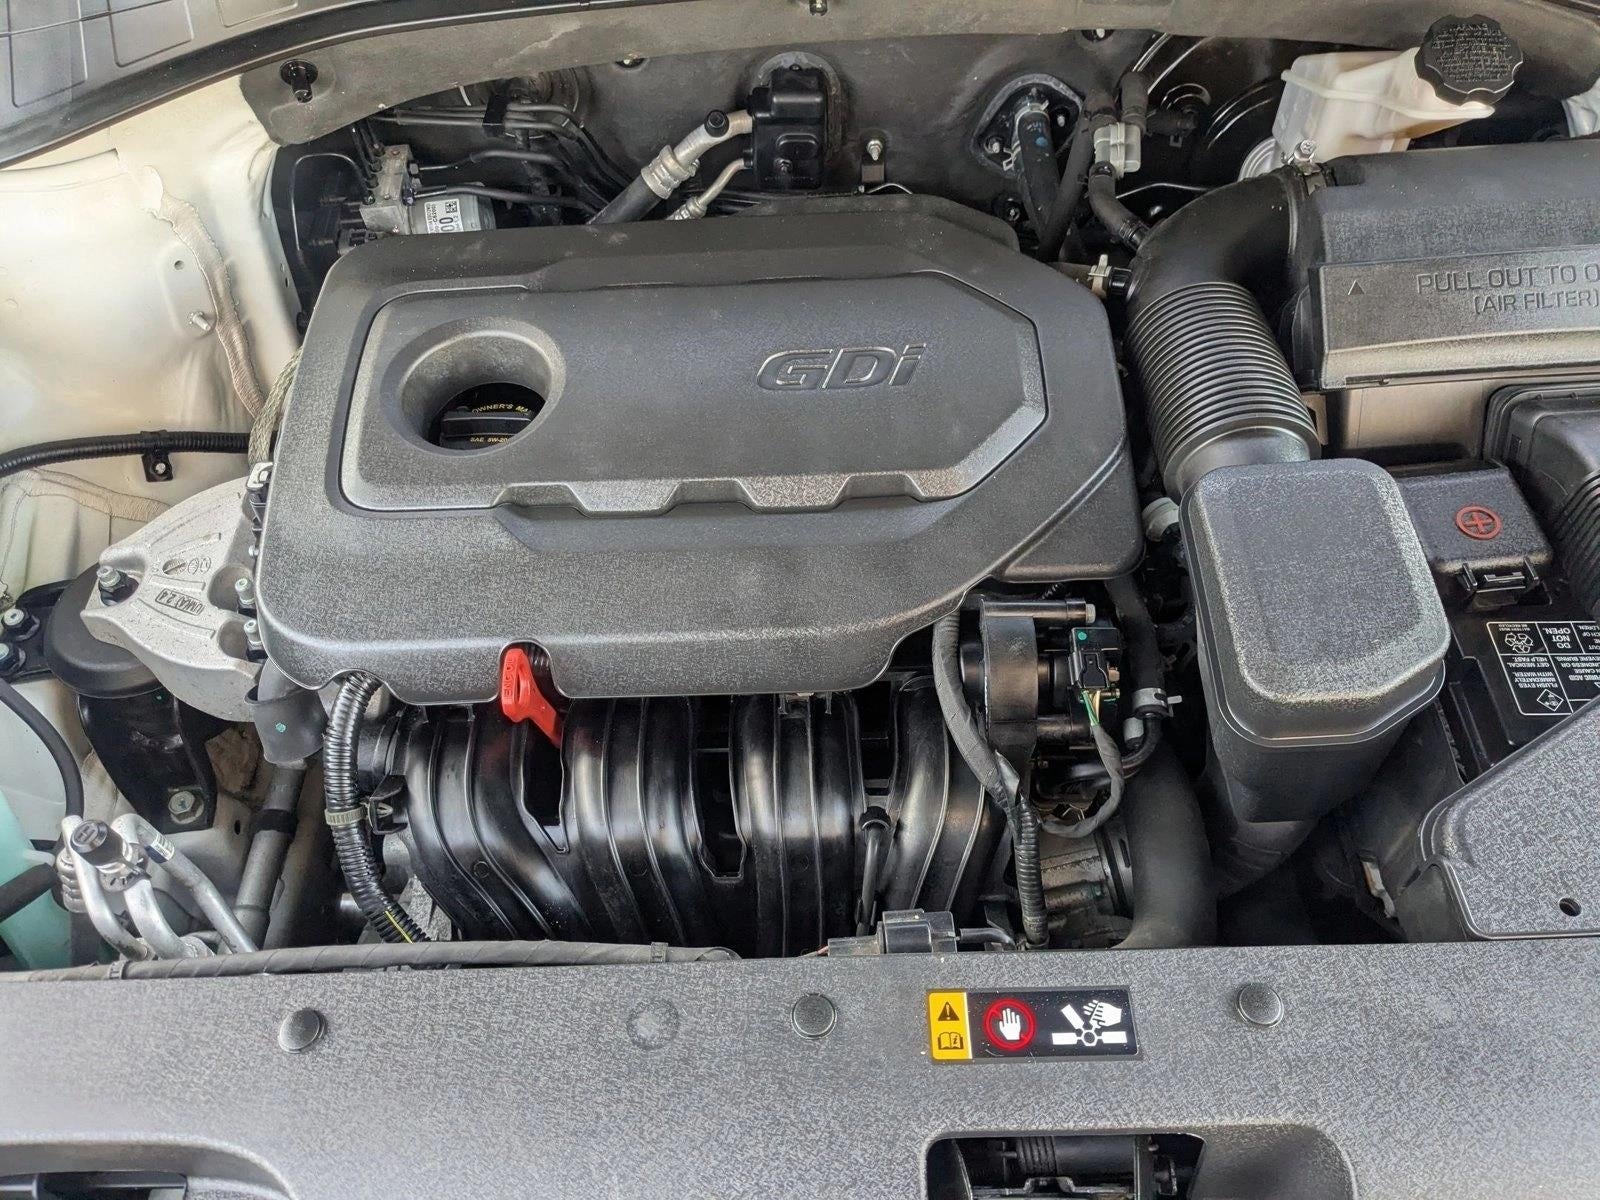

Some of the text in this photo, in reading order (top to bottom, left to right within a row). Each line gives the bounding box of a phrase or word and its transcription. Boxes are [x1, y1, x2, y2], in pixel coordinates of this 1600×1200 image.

[1416, 271, 1482, 294] PULL
[1488, 267, 1537, 289] OUT
[1544, 265, 1577, 284] TO
[756, 343, 926, 390] GDi
[471, 403, 514, 415] OWNER'S
[503, 657, 514, 697] ENG OIL
